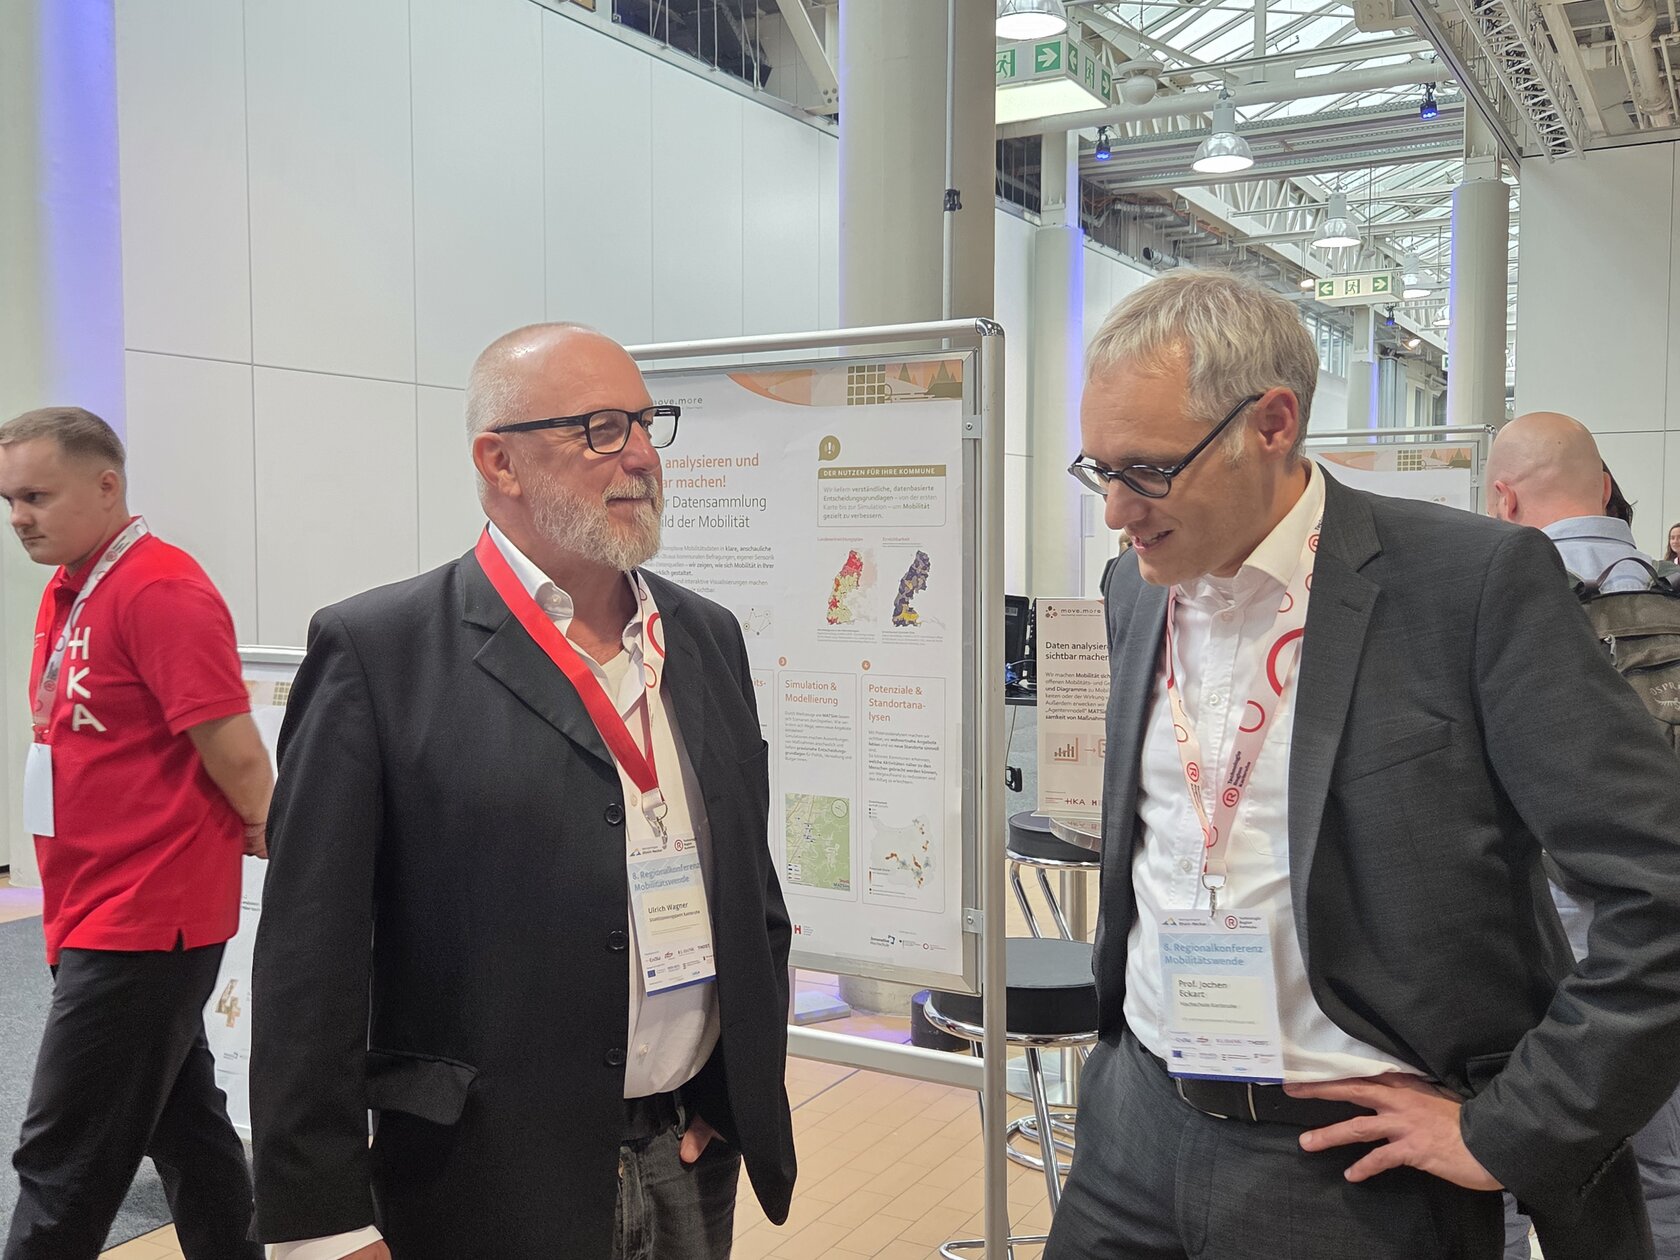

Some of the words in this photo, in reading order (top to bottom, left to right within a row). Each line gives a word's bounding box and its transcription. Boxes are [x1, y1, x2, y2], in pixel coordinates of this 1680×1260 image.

[665, 455, 732, 471] analysieren
[736, 453, 759, 467] und
[899, 467, 935, 475] KOMMUNE
[676, 475, 726, 488] machen!
[672, 494, 767, 511] Datensammlung
[823, 495, 893, 503] Entscheidungsgrundlagen
[661, 515, 674, 527] ild
[677, 514, 695, 528] der
[699, 514, 750, 528] Mobilität
[1046, 642, 1070, 650] Daten
[1071, 642, 1108, 651] analysier
[1046, 652, 1077, 660] sichtbar
[66, 626, 108, 732] HKA
[785, 680, 829, 690] Simulation
[830, 682, 837, 690] &
[868, 684, 913, 695] Potenziale
[915, 687, 922, 695] &
[1649, 682, 1680, 695] OSPR
[785, 694, 838, 707] Modellierung
[869, 698, 926, 709] Standortana-
[869, 712, 890, 723] lysen
[1065, 798, 1085, 806] HKA
[648, 906, 666, 914] Ulrich
[666, 902, 688, 911] Wagner
[1174, 944, 1263, 954] Regionalkonferenz
[1164, 956, 1244, 966] Mobilitätswende
[1178, 980, 1197, 988] Prof.
[1199, 981, 1227, 989] Jochen
[1179, 990, 1205, 998] Eckart
